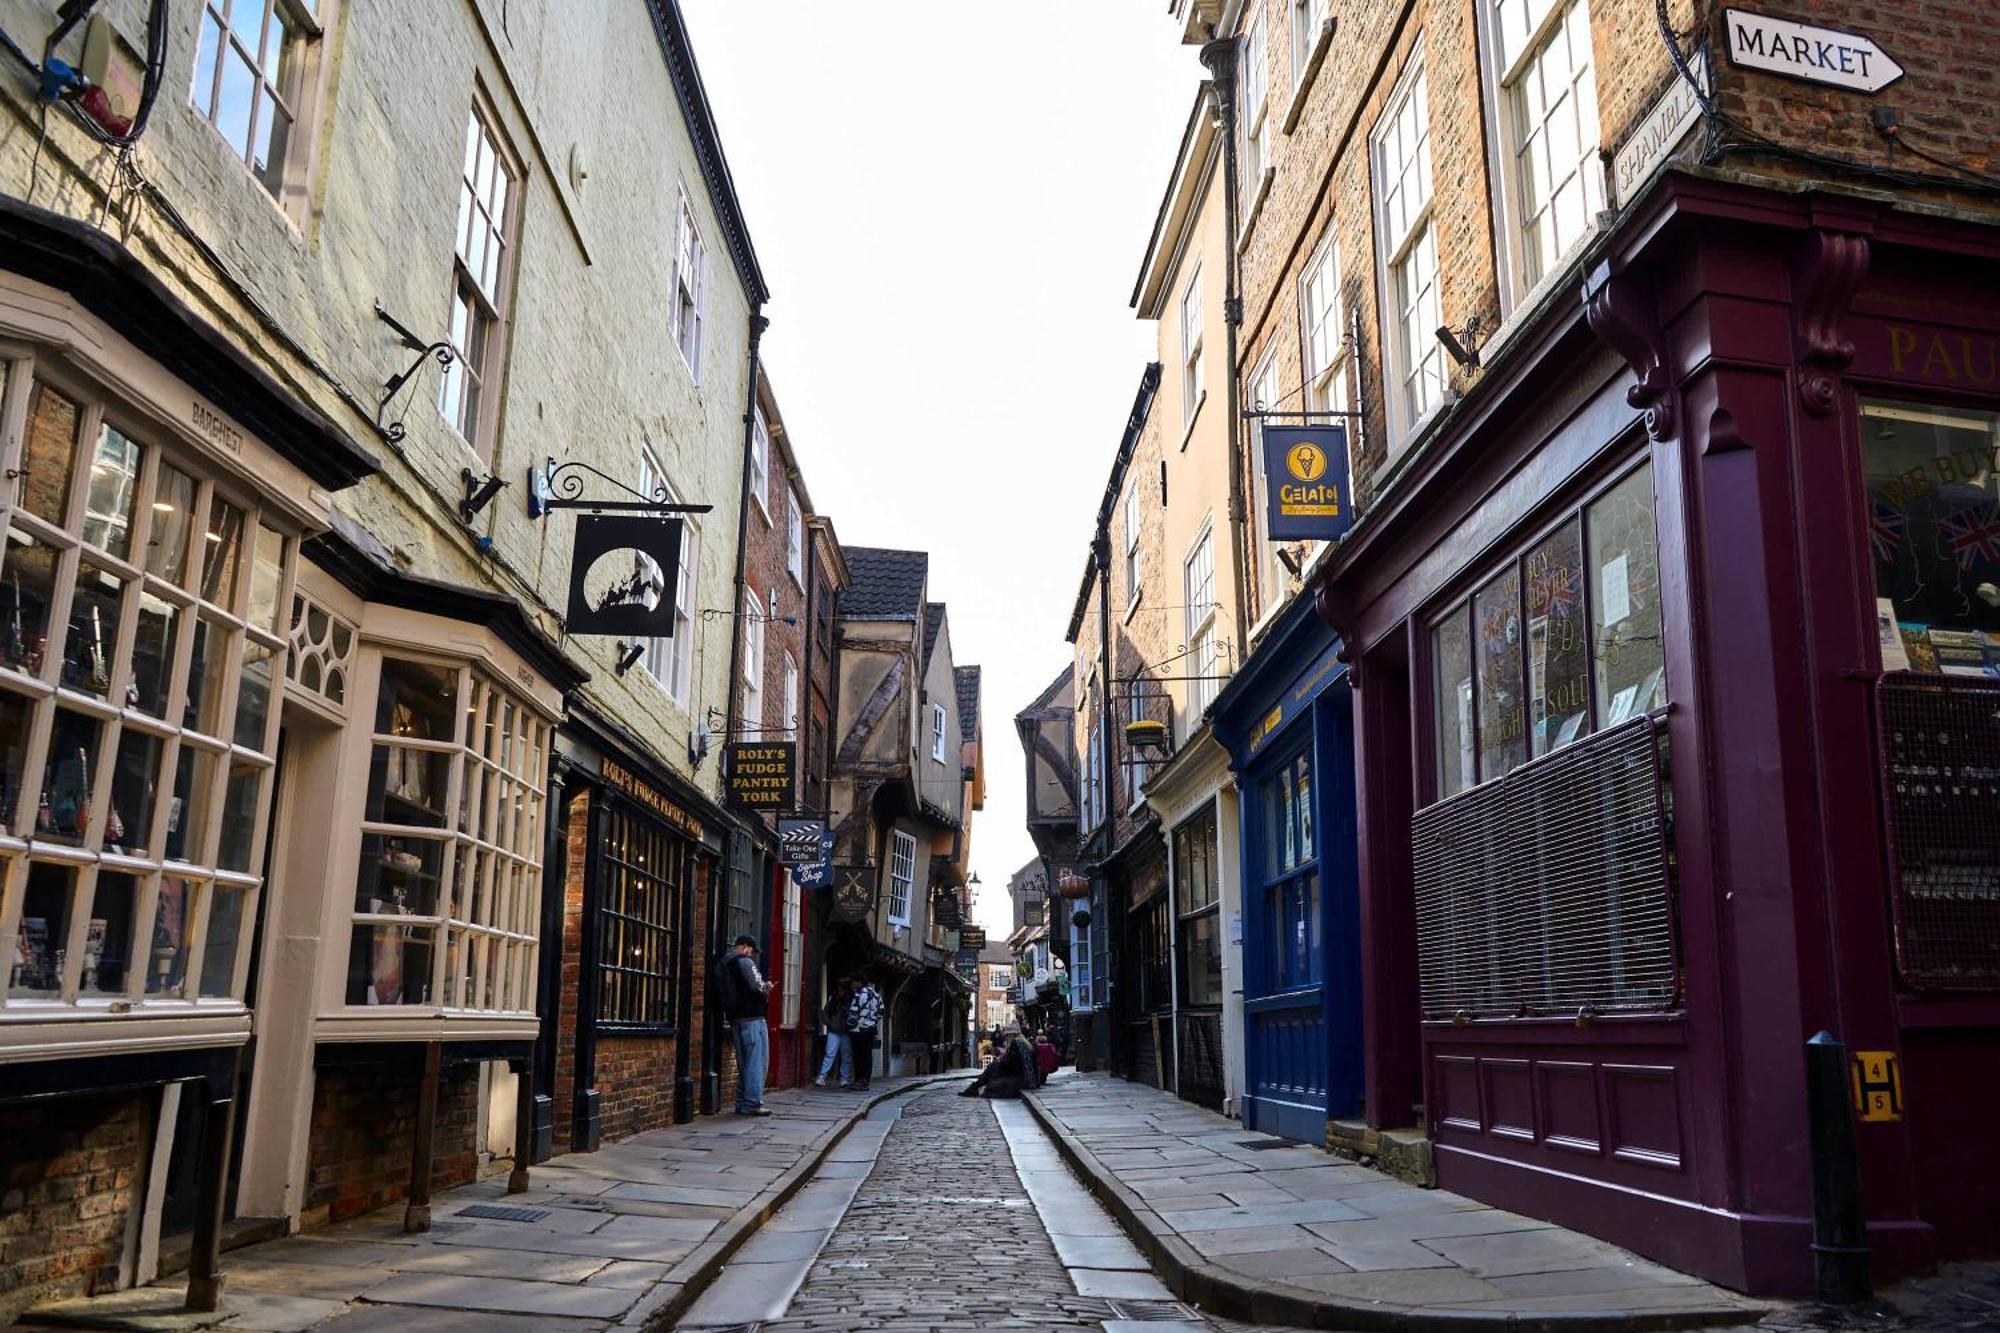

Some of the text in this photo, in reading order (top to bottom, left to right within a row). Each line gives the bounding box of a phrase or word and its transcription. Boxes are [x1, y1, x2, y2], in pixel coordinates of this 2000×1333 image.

[1736, 24, 1872, 78] MARKET
[1620, 76, 1699, 192] SHAMBLE
[1888, 325, 2000, 385] PAU
[191, 401, 243, 456] BARGHEST
[737, 748, 786, 760] ROLY'S
[737, 764, 786, 774] FUDGE
[732, 778, 790, 788] PANTRY
[741, 792, 780, 802] YORK
[784, 844, 801, 852] Take
[803, 844, 818, 852] One
[791, 852, 809, 860] Gifts
[800, 869, 823, 884] Shop
[1872, 1063, 1880, 1078] 4
[1875, 1095, 1884, 1110] 5
